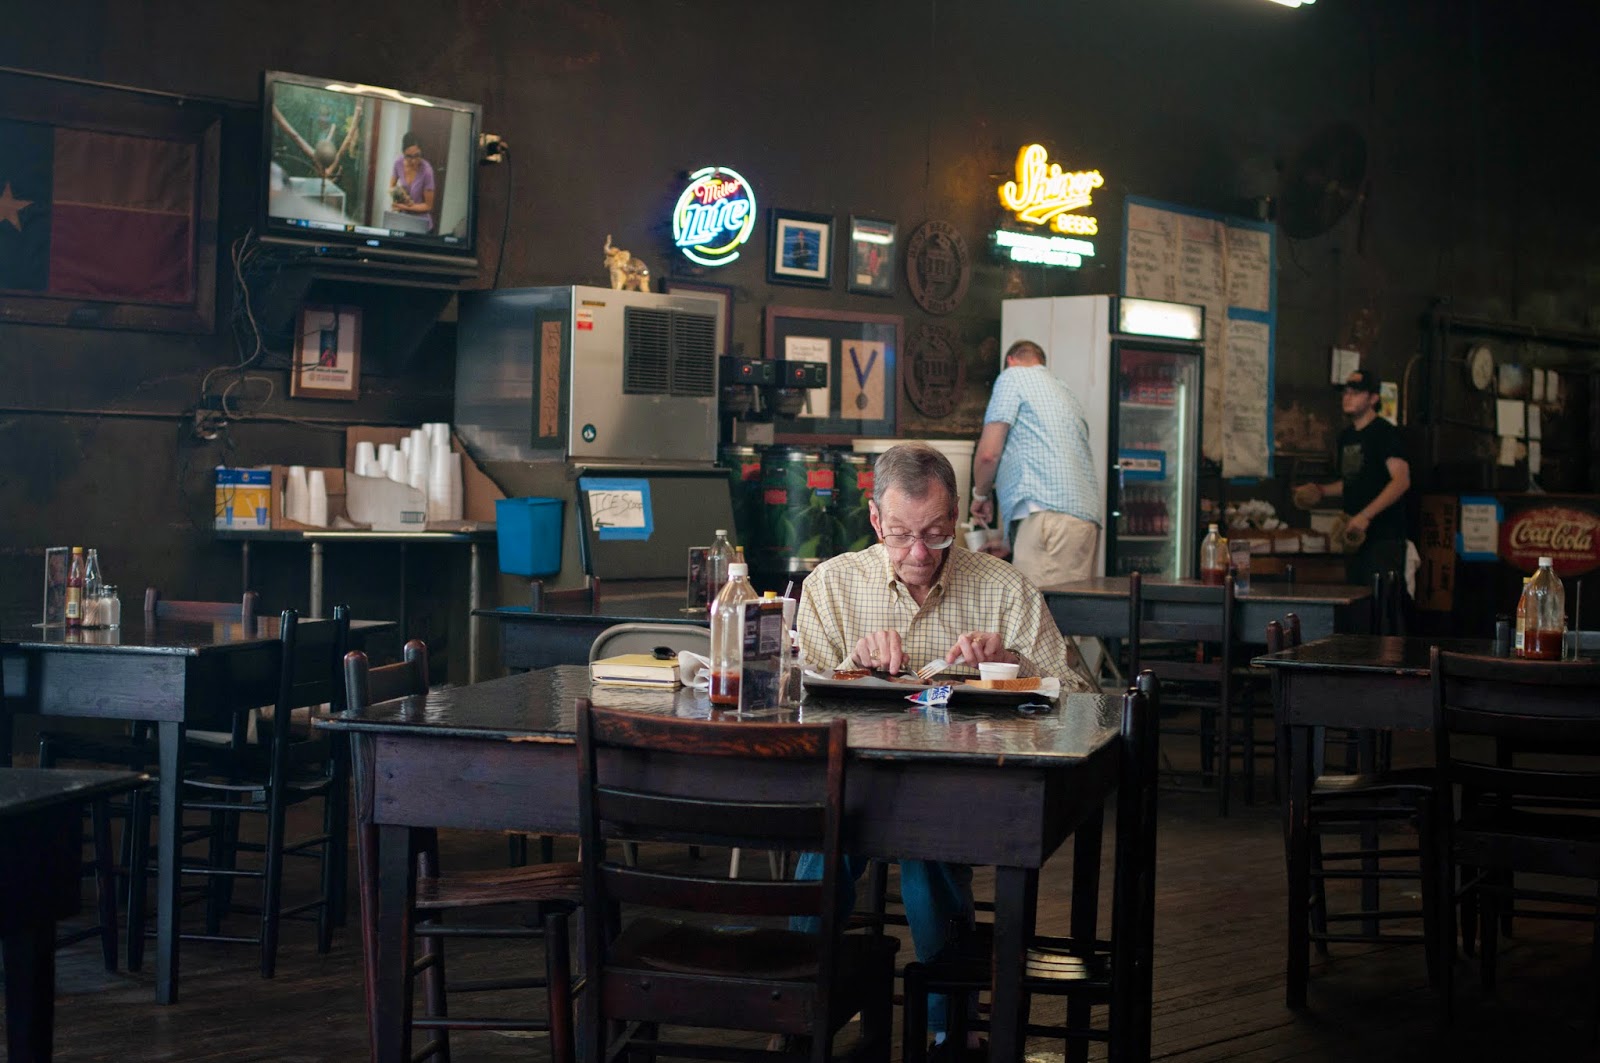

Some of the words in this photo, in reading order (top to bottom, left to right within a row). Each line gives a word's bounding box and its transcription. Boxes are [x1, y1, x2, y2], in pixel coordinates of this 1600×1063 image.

[694, 180, 741, 205] Miller
[1003, 143, 1103, 211] Shiner
[675, 198, 750, 246] Lite
